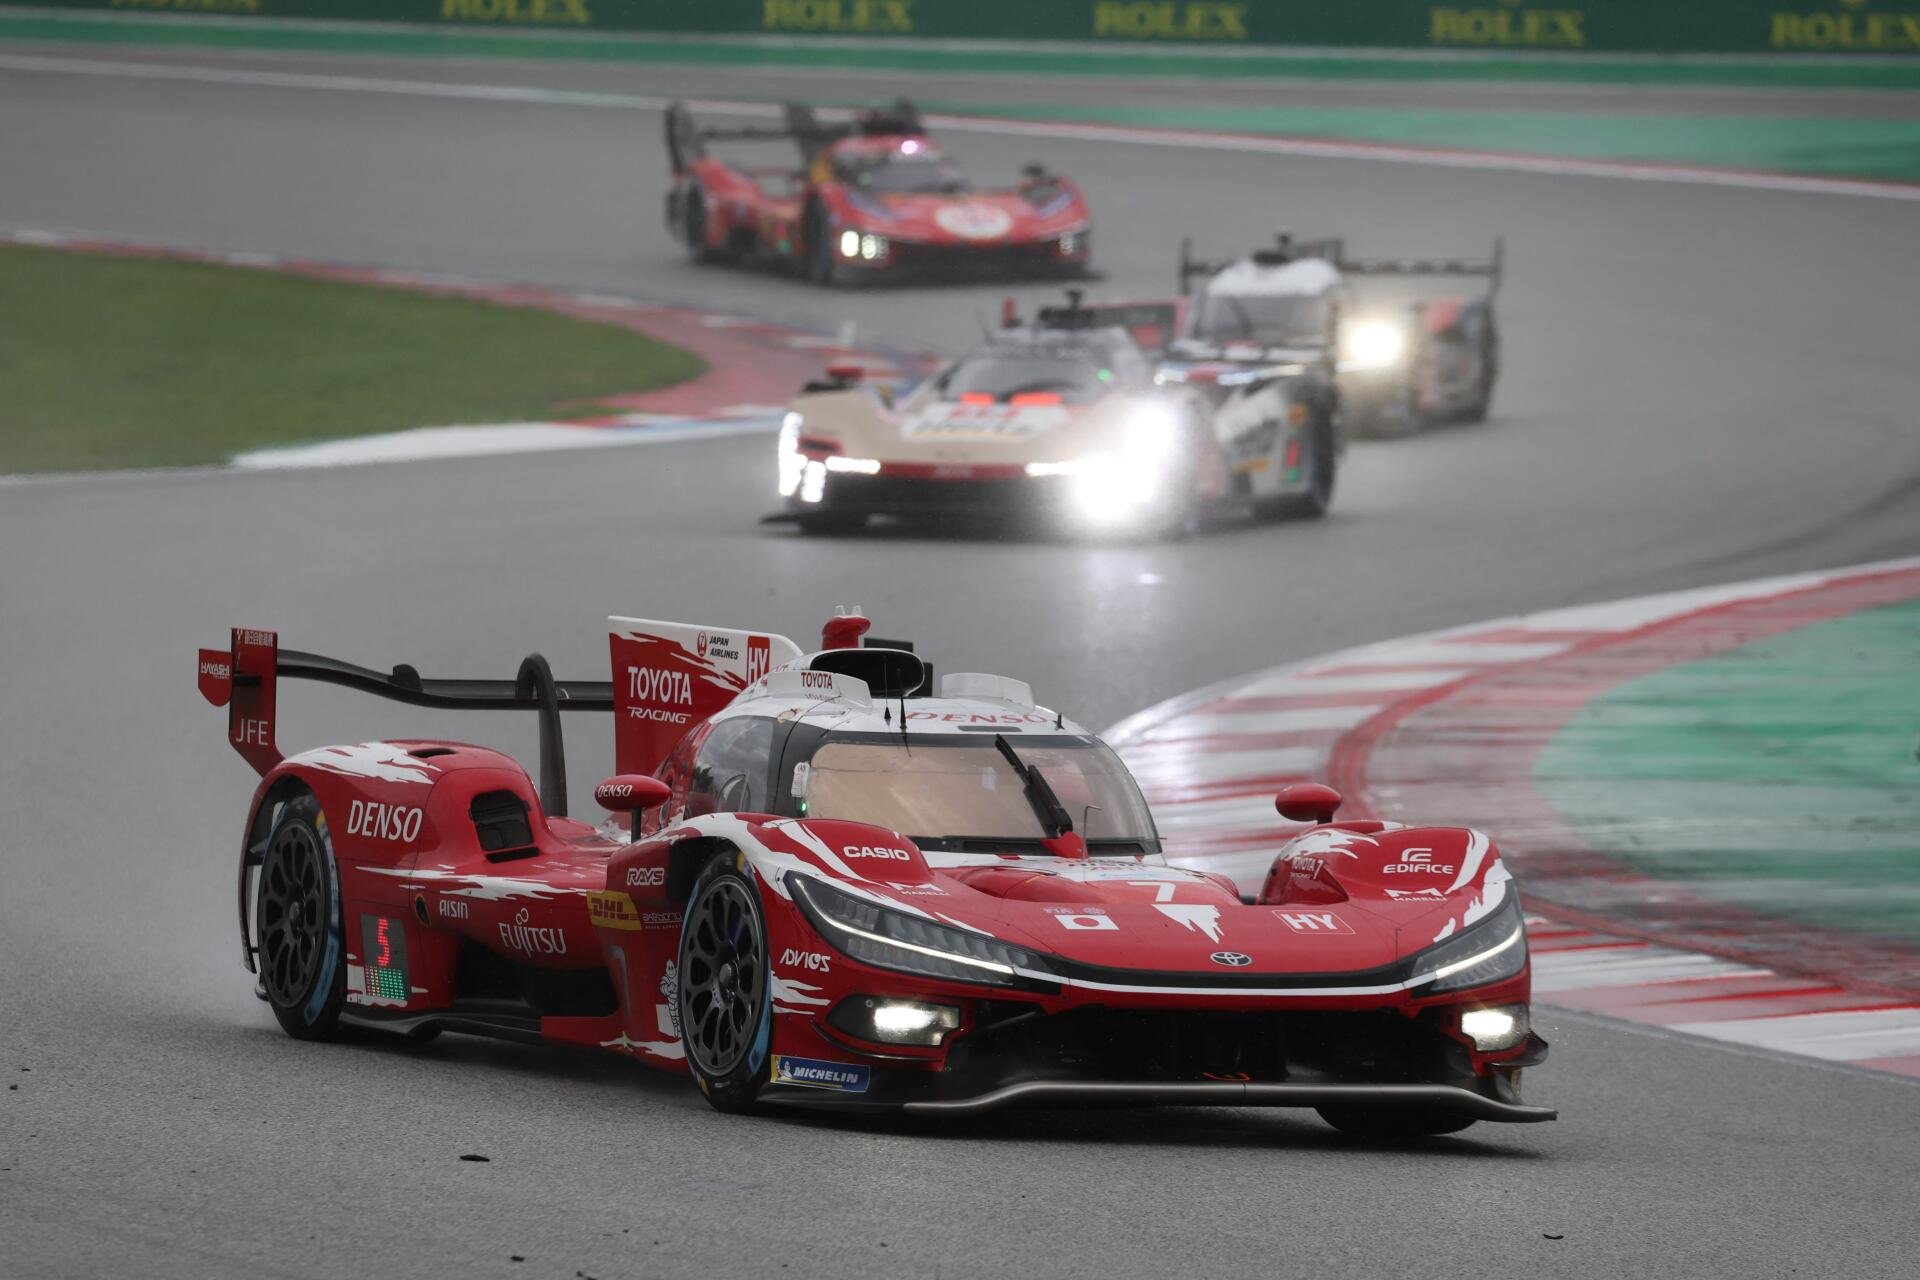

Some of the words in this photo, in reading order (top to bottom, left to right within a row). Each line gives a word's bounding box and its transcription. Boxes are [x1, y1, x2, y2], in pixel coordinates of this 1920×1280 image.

[764, 0, 913, 31] ROLEX
[1094, 3, 1247, 37] ROLEX
[1431, 8, 1587, 46] ROLEX
[709, 635, 729, 646] JAPAN
[710, 648, 739, 660] AIRLINES
[200, 662, 231, 676] HAYASHI
[627, 666, 693, 706] TOYOTA
[801, 672, 833, 690] TOYOTA
[626, 706, 692, 724] RACING
[904, 711, 1049, 724] DENSO
[236, 718, 269, 747] JFE
[597, 784, 633, 798] DENSO
[346, 799, 424, 844] DENSO
[843, 845, 911, 861] CASIO
[627, 867, 665, 886] RAYS
[1382, 863, 1455, 875] EDIFICE
[1126, 881, 1177, 903] 7
[440, 899, 469, 920] AISIN
[1280, 913, 1338, 931] HY
[376, 917, 391, 968] 5
[498, 922, 567, 958] FUJITSU
[779, 948, 831, 973] ADVICS
[793, 1066, 859, 1084] MICHELIN
